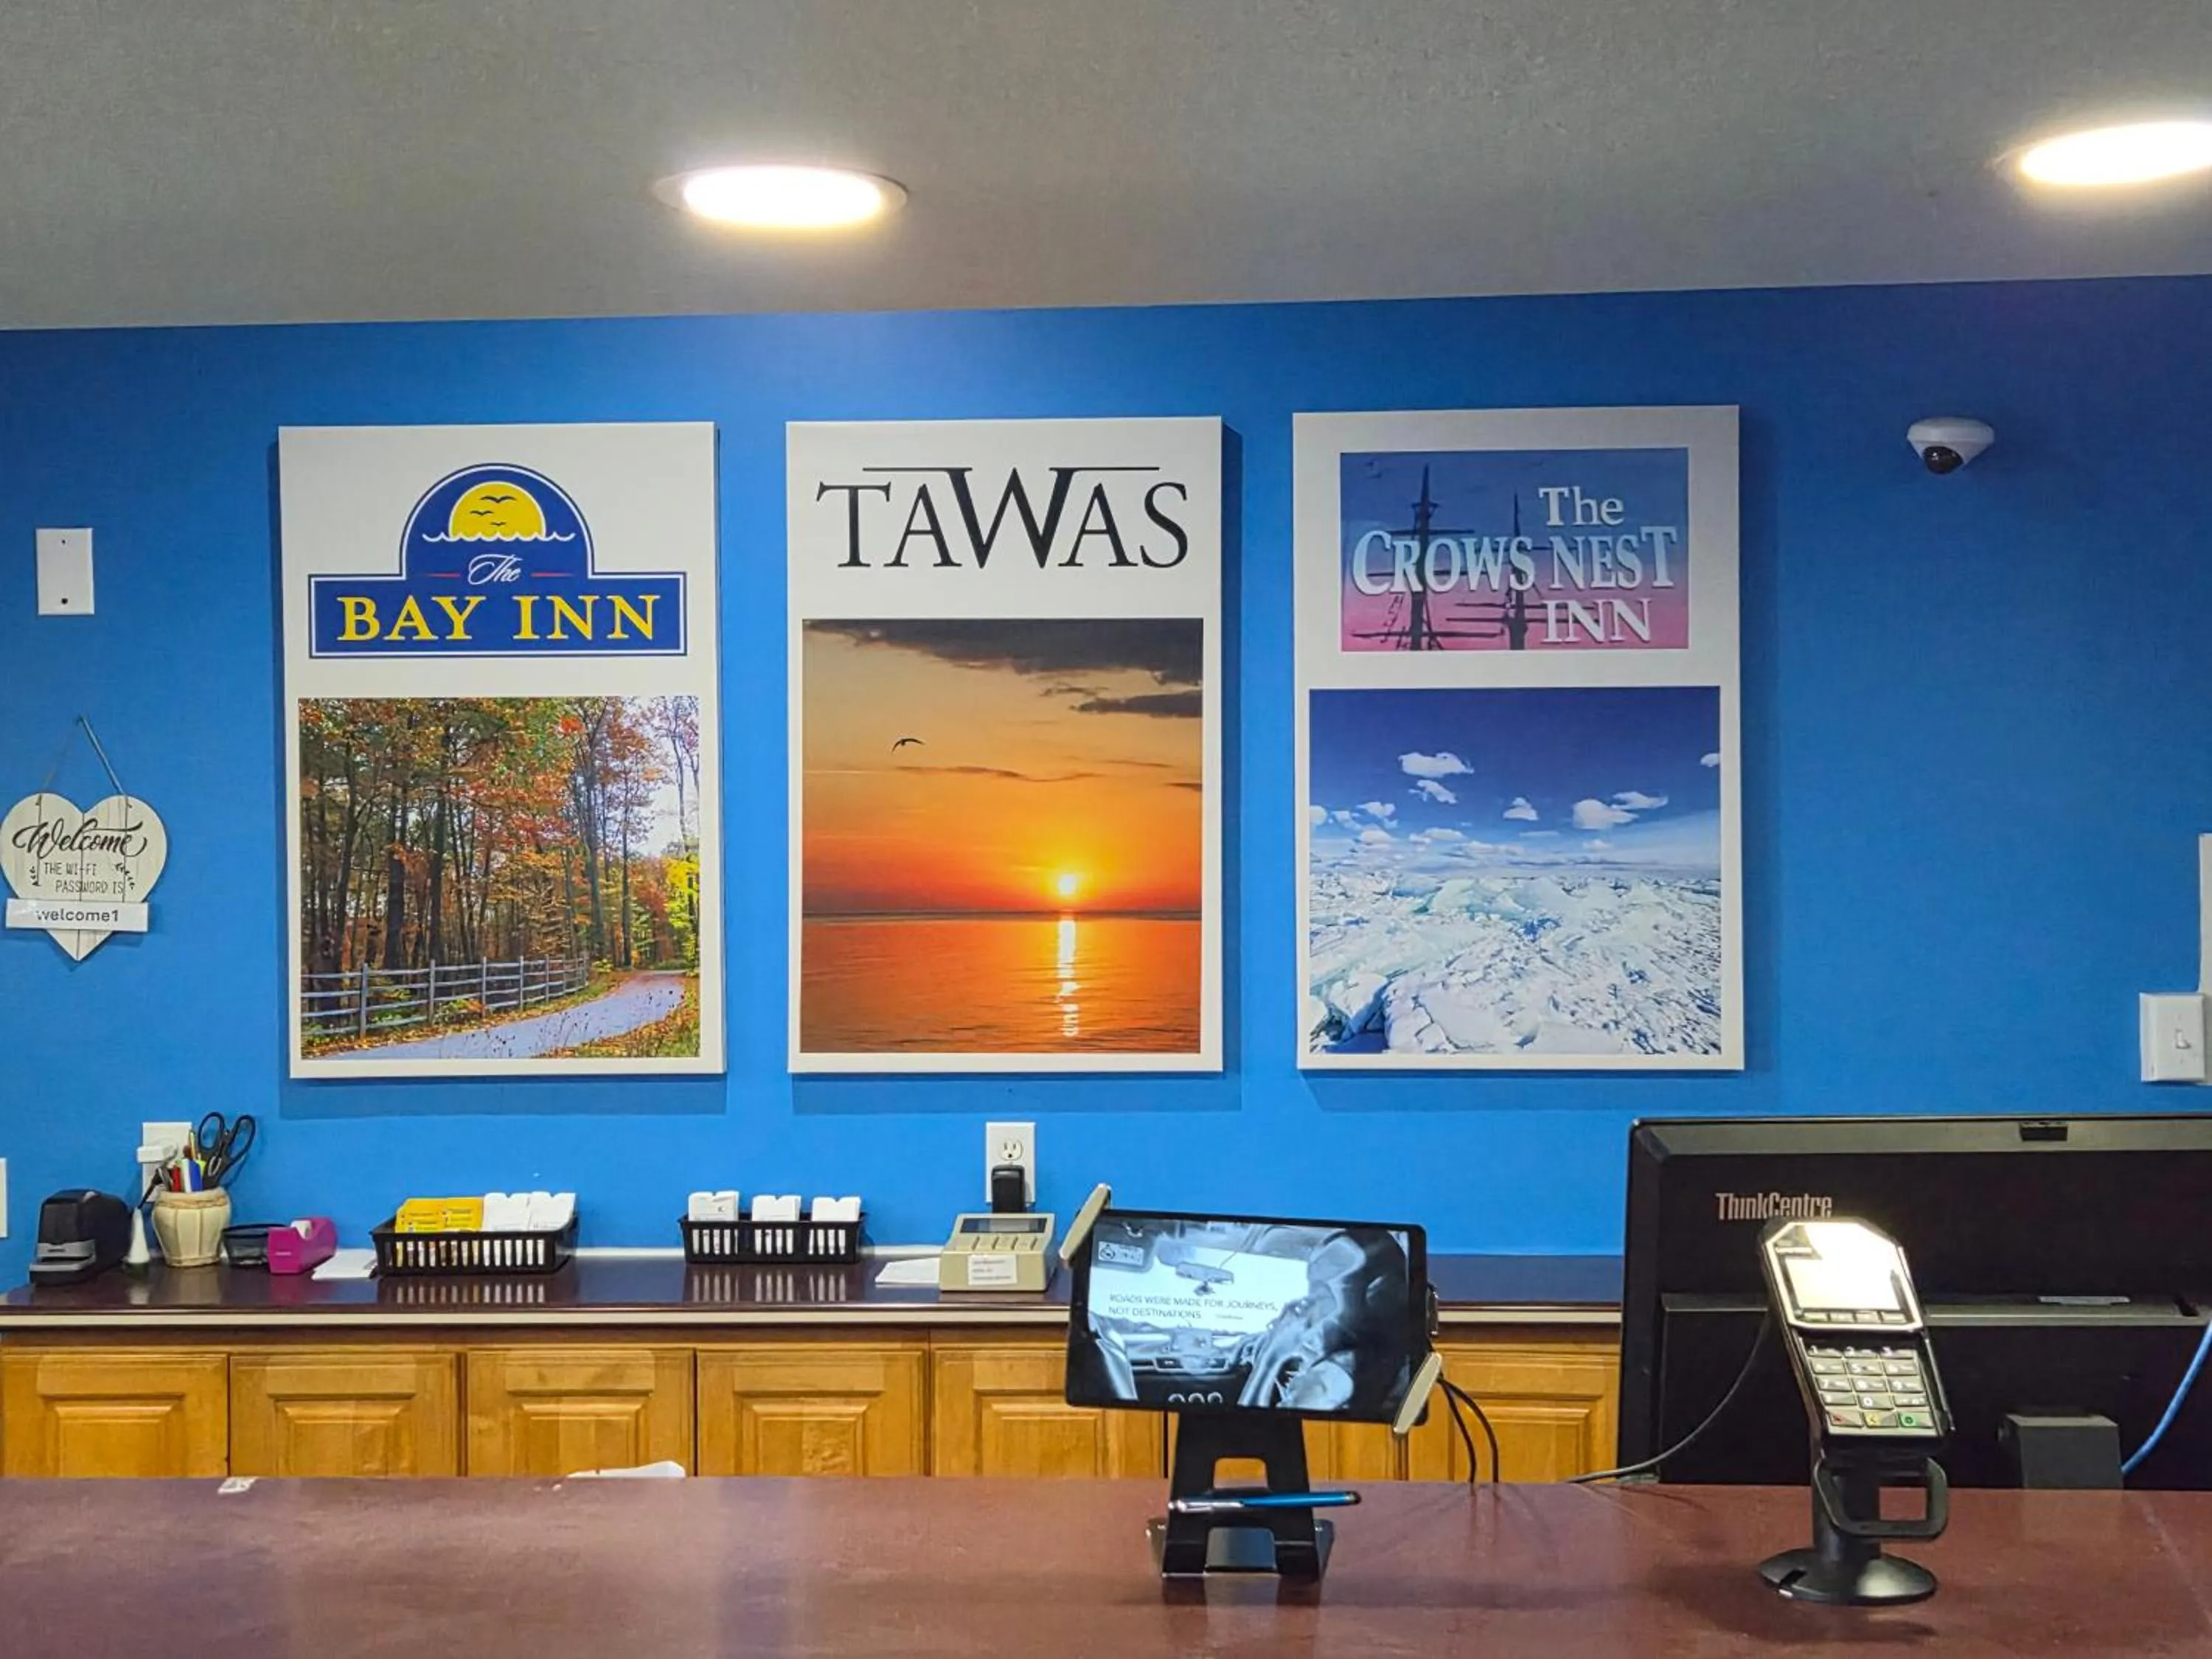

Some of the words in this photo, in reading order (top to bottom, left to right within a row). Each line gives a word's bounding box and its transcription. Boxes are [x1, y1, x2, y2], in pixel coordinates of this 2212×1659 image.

[816, 467, 1189, 568] TAWAS
[1539, 486, 1624, 526] The
[467, 554, 522, 585] The
[1352, 529, 1535, 596] CROWS
[1548, 525, 1678, 590] NEST
[337, 594, 487, 641] BAY
[512, 594, 661, 641] INN
[1540, 597, 1652, 644] INN
[12, 818, 147, 859] Welcome
[44, 862, 62, 874] THE
[66, 863, 97, 876] WI-FI
[55, 880, 108, 894] PASSWORD
[113, 881, 124, 894] IS
[35, 908, 119, 922] welcome1
[1715, 1192, 1832, 1220] ThinkCentre
[1108, 1306, 1130, 1315] NOT
[1110, 1293, 1142, 1304] ROADS
[1144, 1295, 1171, 1306] WERE
[1173, 1297, 1203, 1308] MADE
[1204, 1298, 1223, 1308] FOR
